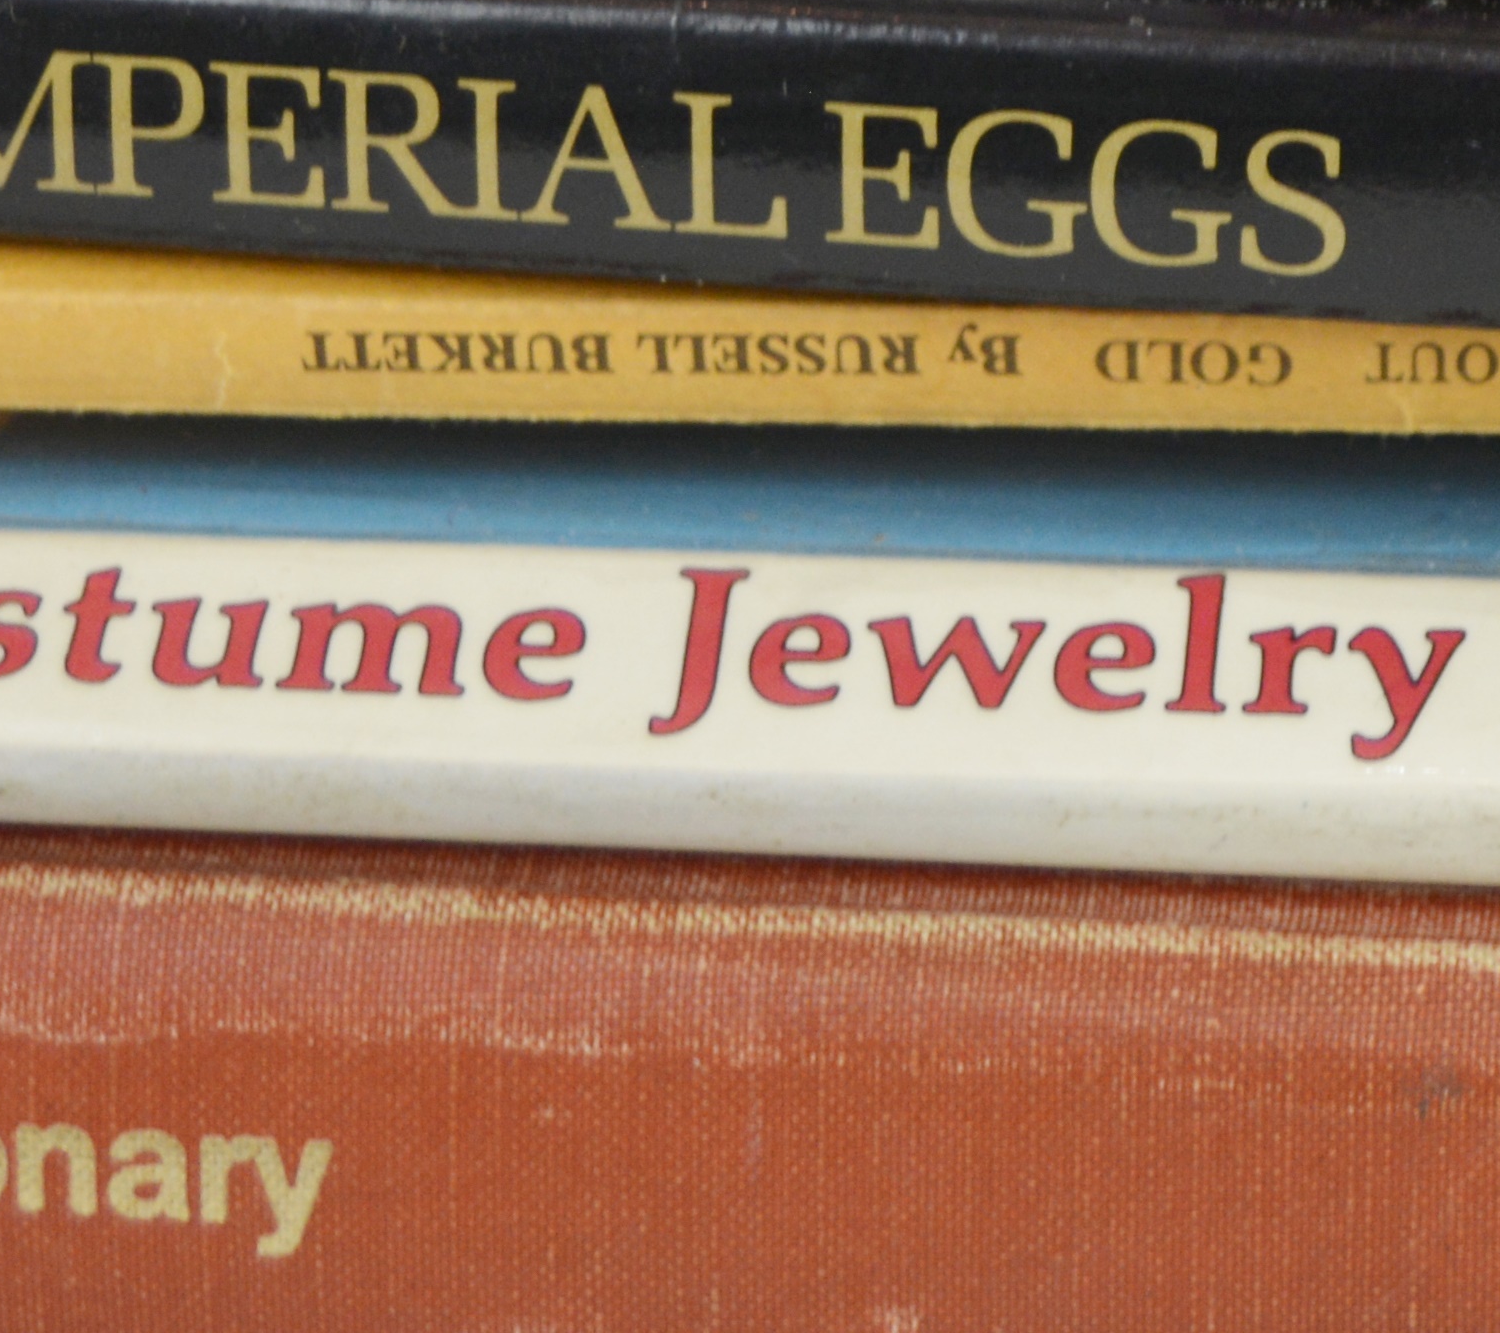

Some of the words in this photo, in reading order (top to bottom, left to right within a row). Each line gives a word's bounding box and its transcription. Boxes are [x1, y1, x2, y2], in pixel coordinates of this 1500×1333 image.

[824, 101, 1349, 279] EGGS
[301, 330, 612, 375] BURKETT
[636, 332, 919, 376] RUSSELL
[947, 322, 1021, 377] By
[1095, 339, 1293, 387] GOLD
[646, 566, 1468, 762] Jewelry
